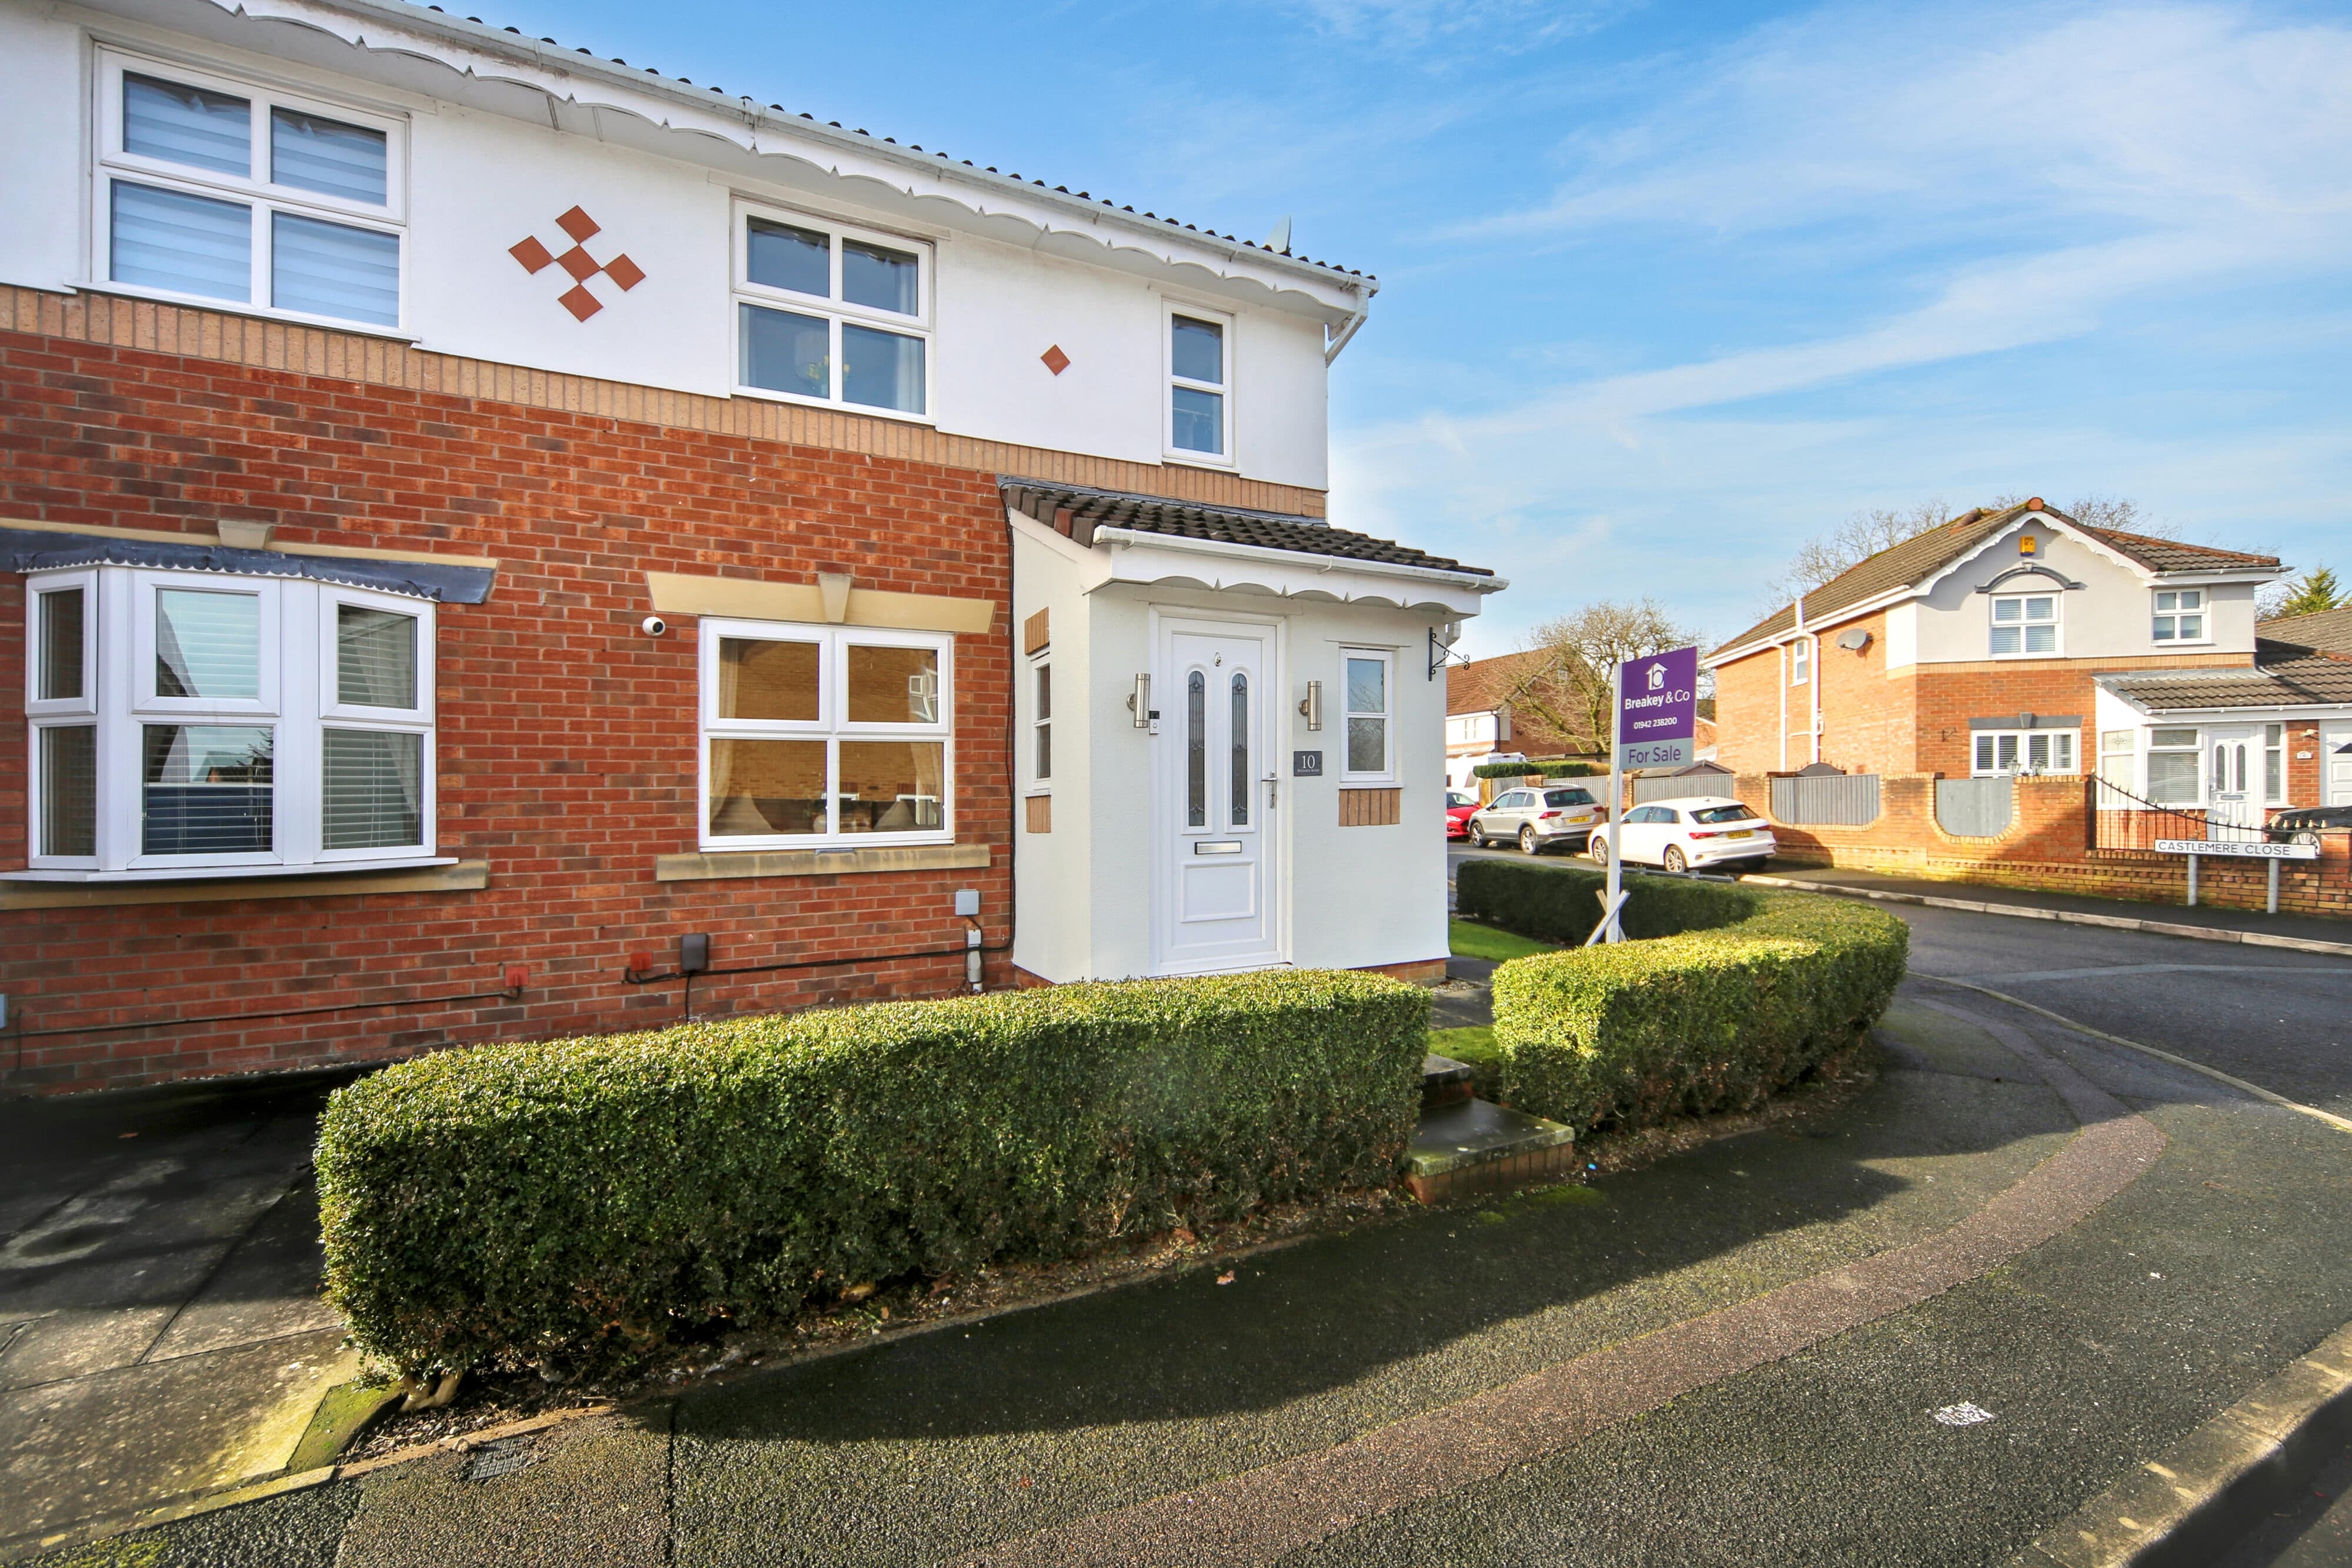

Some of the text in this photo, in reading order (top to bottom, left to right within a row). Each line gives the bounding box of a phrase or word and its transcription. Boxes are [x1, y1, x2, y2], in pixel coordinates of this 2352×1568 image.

[1625, 689, 1690, 710] Breakey & Co
[1633, 717, 1677, 730] 01942 238200
[1301, 755, 1315, 768] 10
[1629, 745, 1681, 764] For Sale
[2159, 841, 2291, 856] CASTLEMERE CLOSE
